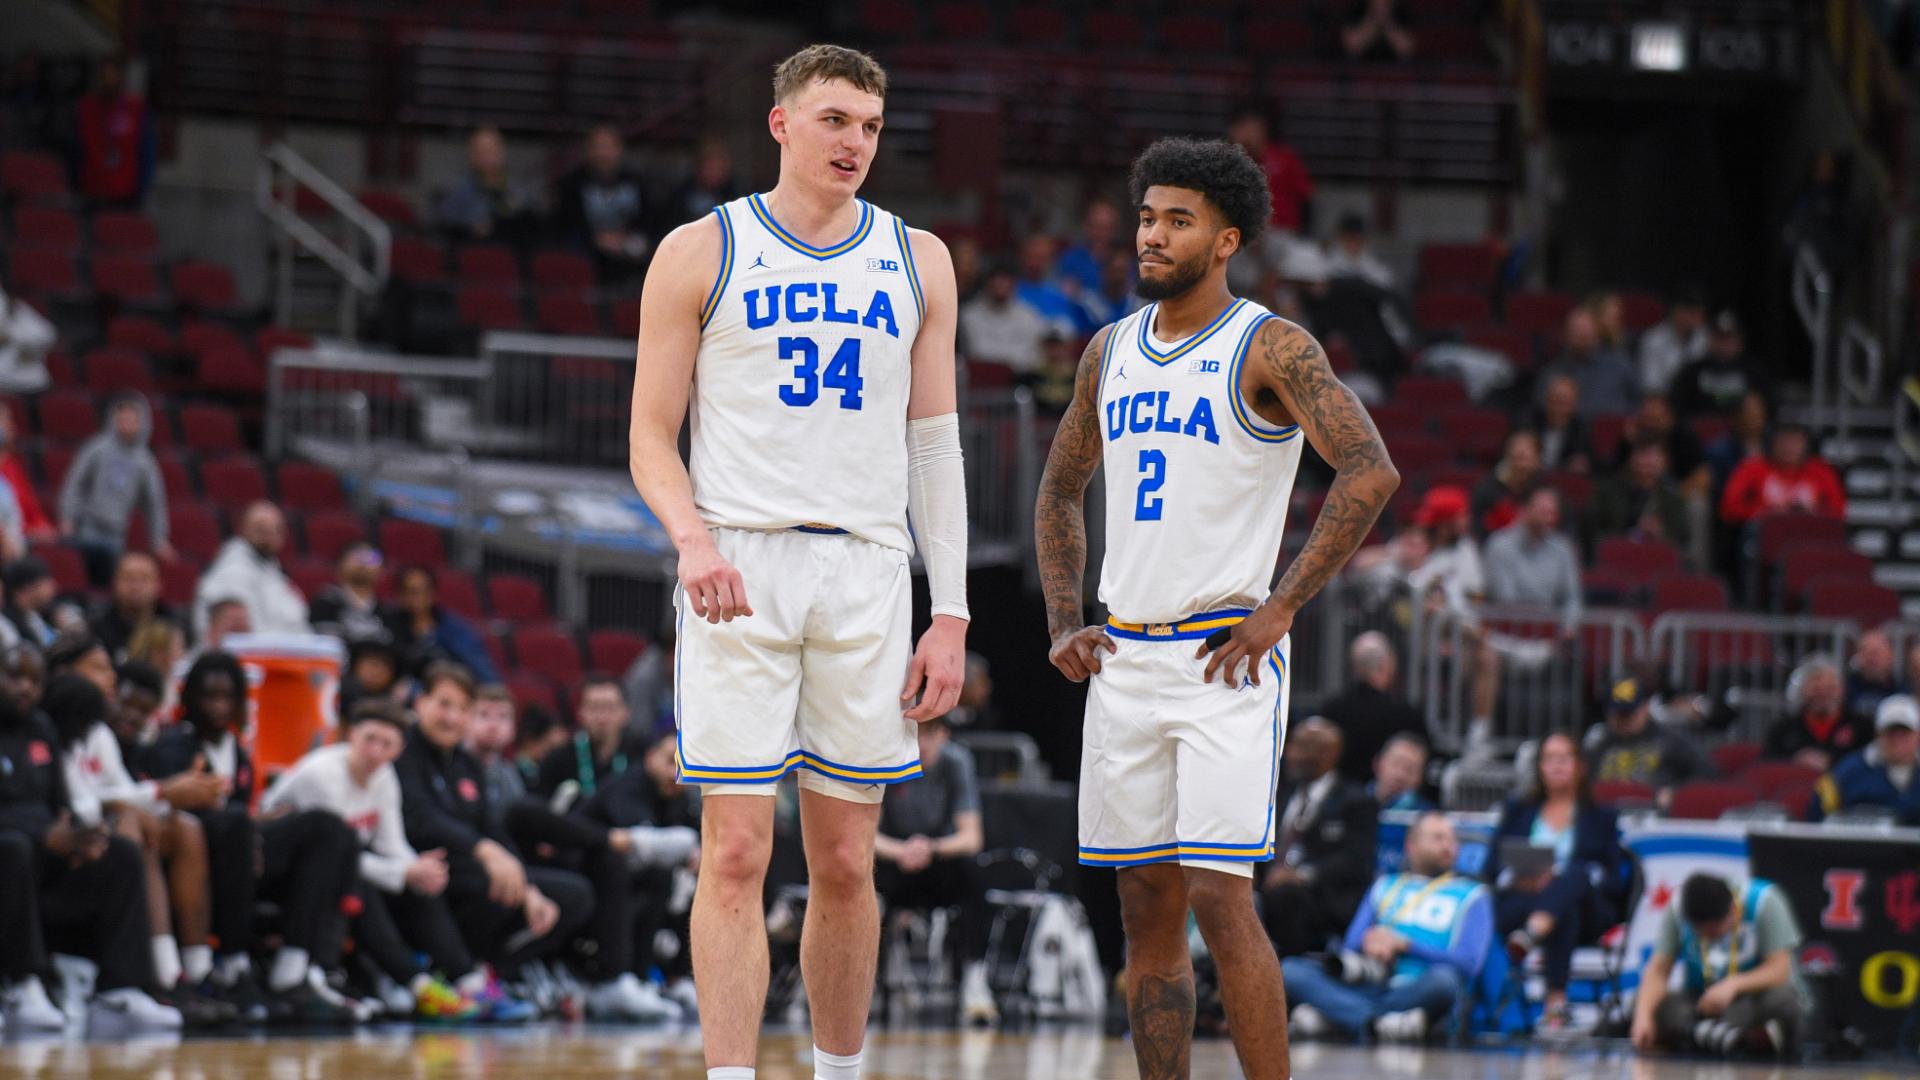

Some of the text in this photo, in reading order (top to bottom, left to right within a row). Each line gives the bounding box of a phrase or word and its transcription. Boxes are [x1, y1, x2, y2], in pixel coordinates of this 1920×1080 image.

[743, 282, 900, 338] UCLA
[778, 337, 864, 410] 34
[1106, 390, 1221, 444] UCLA
[1134, 449, 1167, 522] 2
